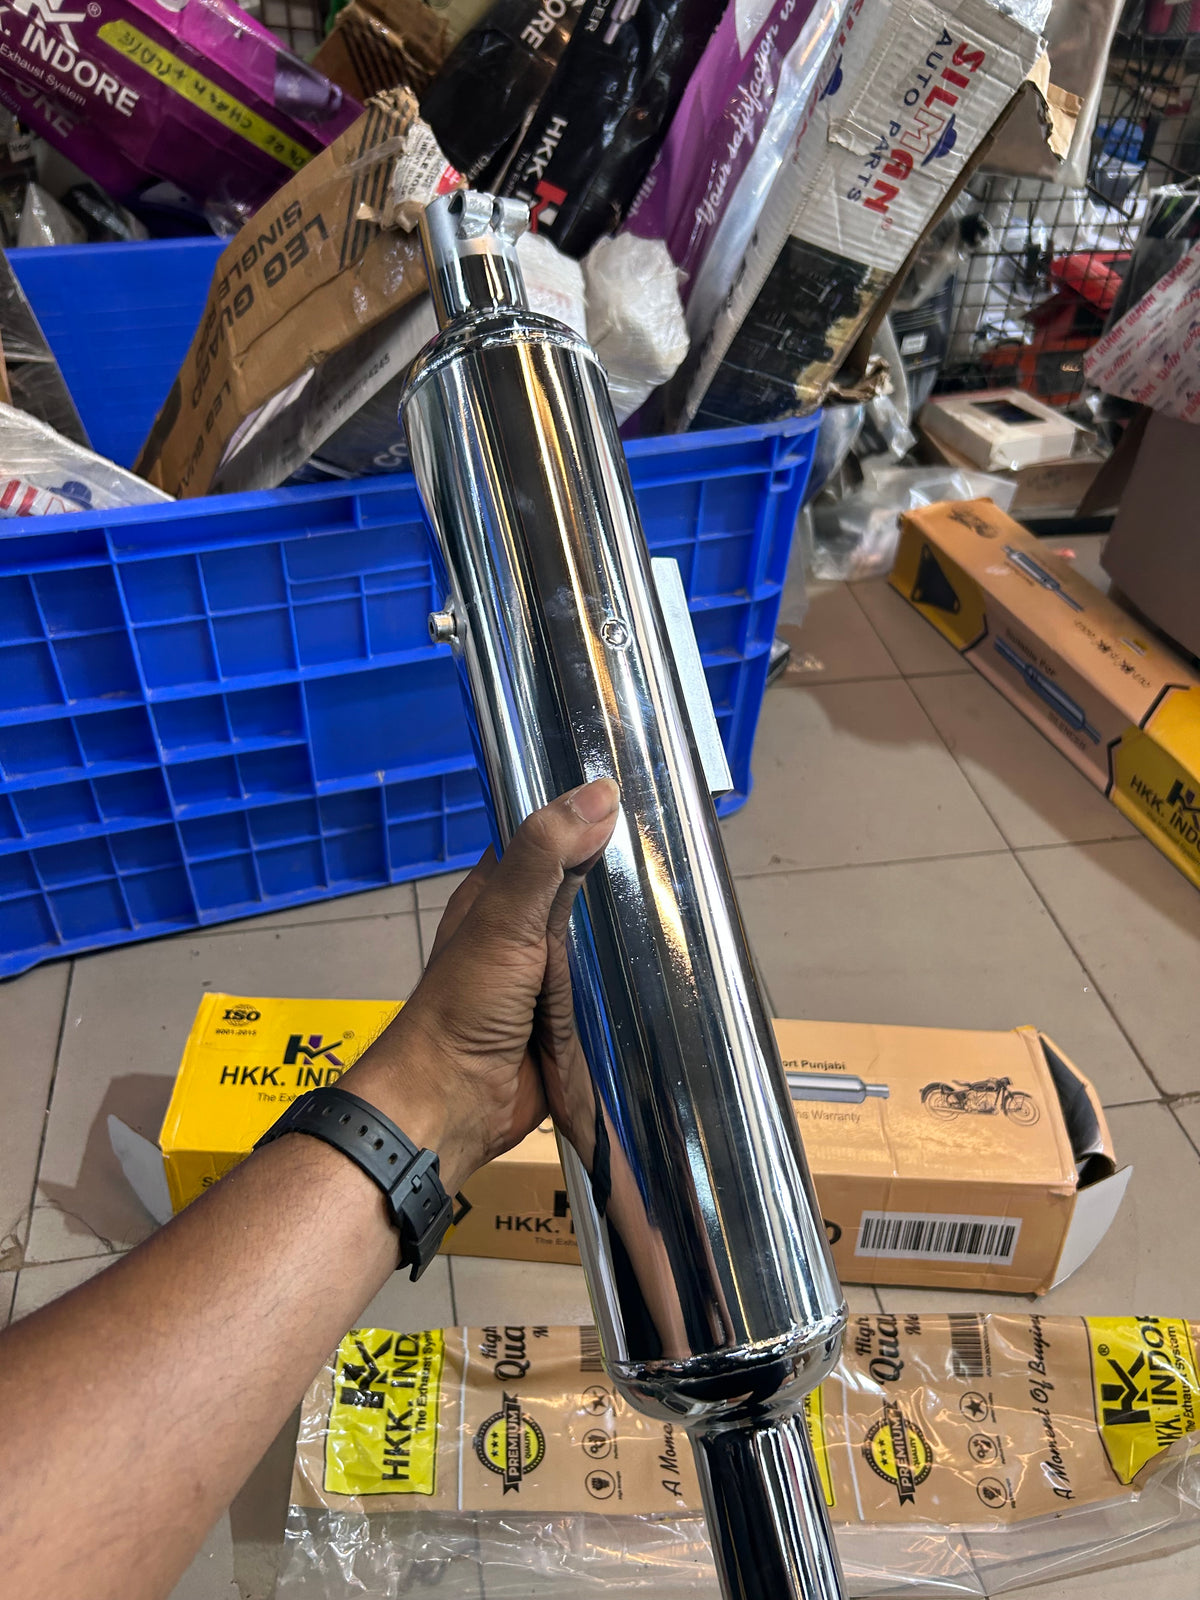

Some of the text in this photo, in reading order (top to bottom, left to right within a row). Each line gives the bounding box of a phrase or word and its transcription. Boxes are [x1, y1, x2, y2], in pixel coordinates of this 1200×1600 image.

[1, 43, 48, 80] Exhaust
[46, 74, 87, 107] System
[21, 23, 140, 118] INDORE
[695, 163, 732, 226] Your
[726, 23, 779, 162] satisfaction
[846, 29, 953, 203] AUTO PARTS
[863, 41, 986, 215] SILMAN
[522, 116, 569, 182] HKK.
[217, 200, 303, 301] SINGLE
[263, 213, 330, 288] LEG
[206, 378, 232, 434] LEG
[1131, 774, 1166, 817] HKK.
[222, 1008, 261, 1022] ISO
[219, 1065, 286, 1087] HKK.
[801, 1060, 846, 1071] Punjabi
[257, 1092, 276, 1103] The
[811, 1109, 861, 1123] Warranty
[495, 1215, 560, 1233] HKK.
[535, 1236, 553, 1245] The
[480, 1326, 503, 1360] High
[854, 1316, 876, 1356] High
[416, 1356, 432, 1408] Exhaust
[1028, 1379, 1053, 1404] Of
[382, 1400, 414, 1481] HKK.
[414, 1409, 428, 1434] The
[507, 1409, 521, 1476] PREMIUM
[523, 1429, 532, 1460] QUALITY
[889, 1415, 914, 1488] PREMIUM
[909, 1436, 921, 1468] QUALITY
[1032, 1407, 1071, 1483] Moment
[661, 1479, 683, 1497] A
[1053, 1486, 1076, 1500] A
